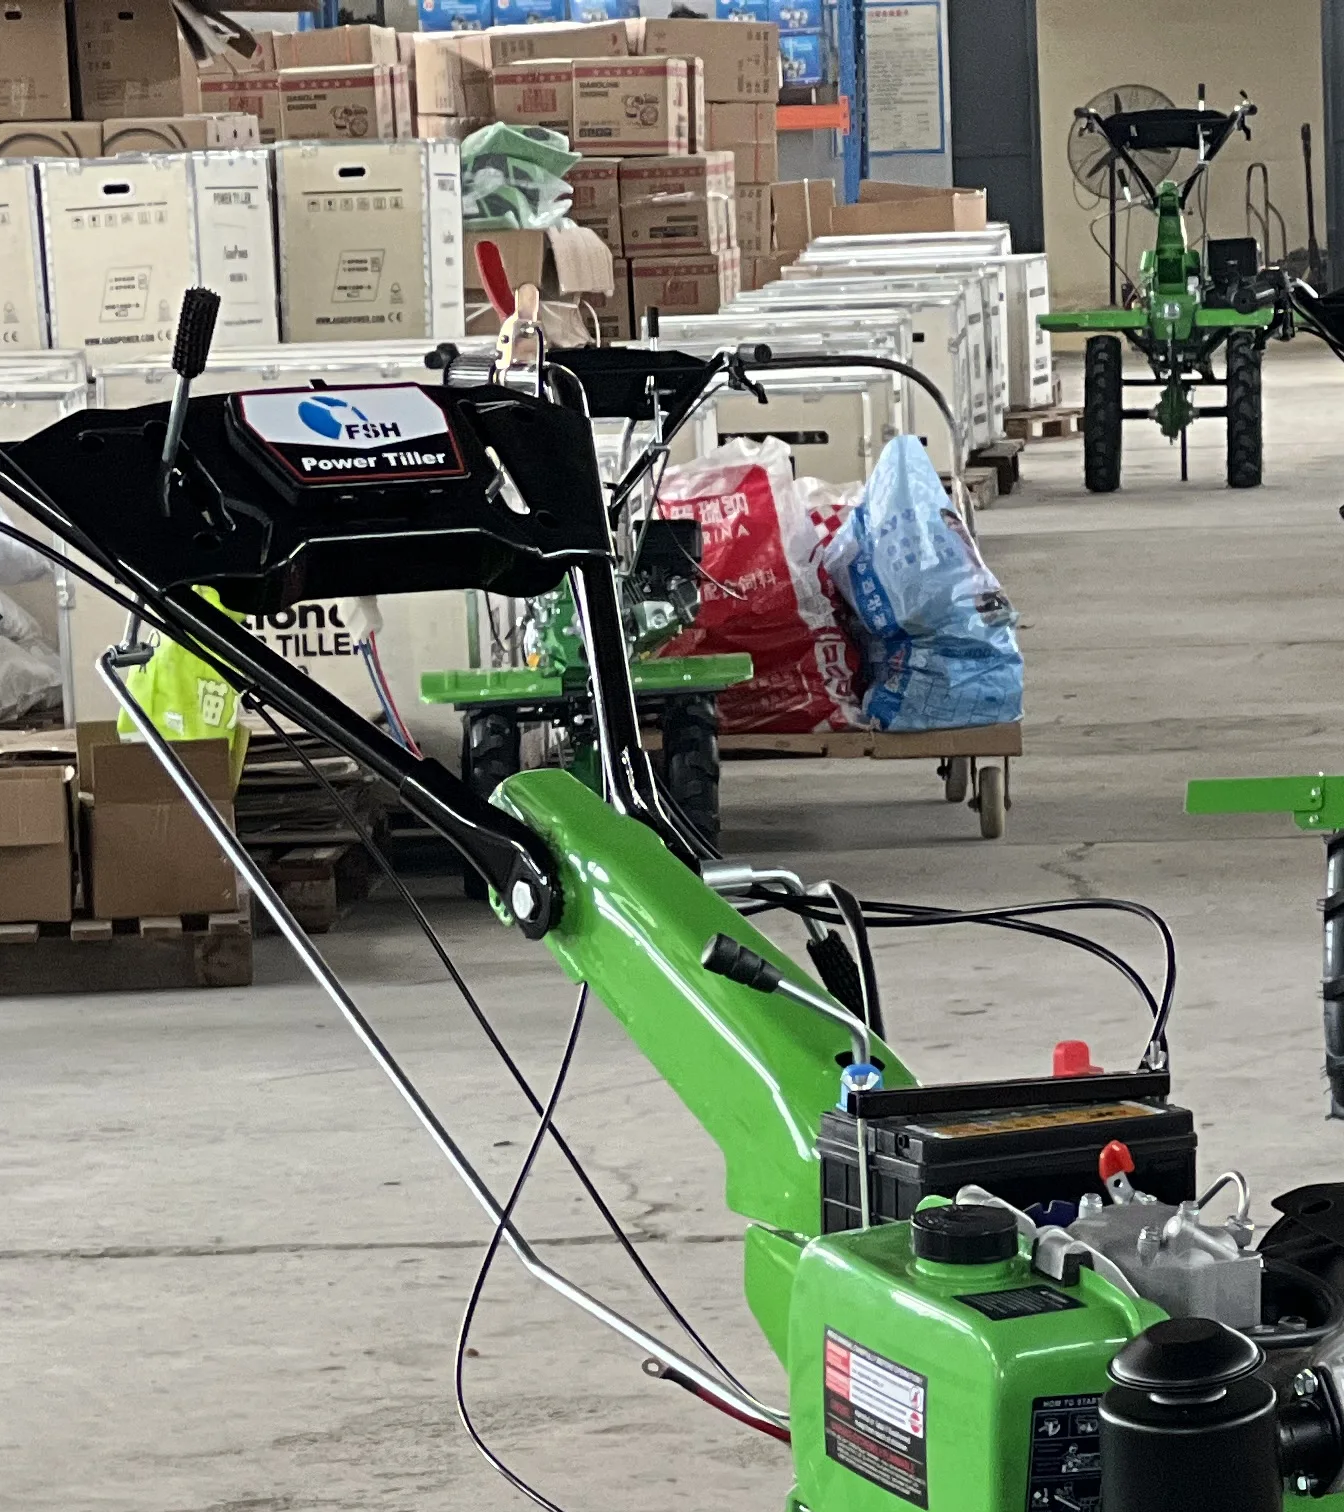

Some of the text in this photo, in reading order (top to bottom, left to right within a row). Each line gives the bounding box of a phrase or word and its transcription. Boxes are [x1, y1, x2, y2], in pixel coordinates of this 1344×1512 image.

[345, 422, 402, 440] FSH
[301, 451, 446, 471] Power Tiller
[702, 523, 751, 544] RINA
